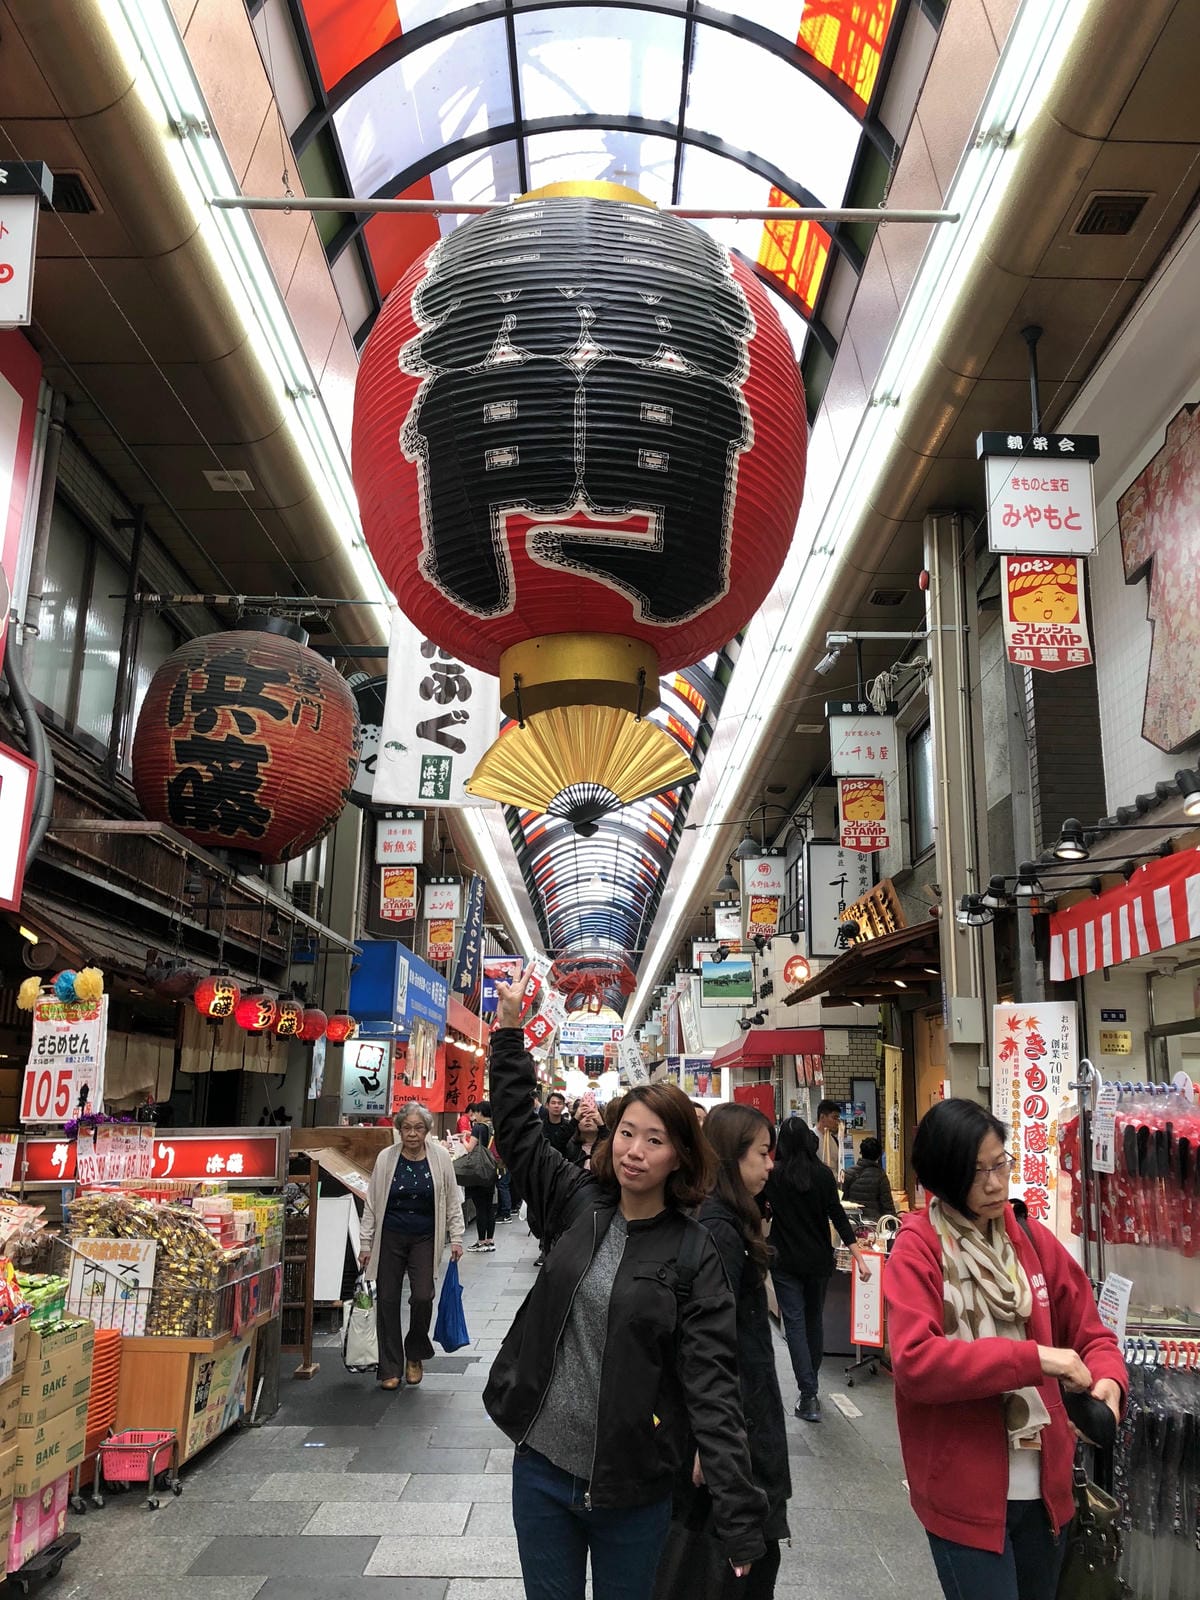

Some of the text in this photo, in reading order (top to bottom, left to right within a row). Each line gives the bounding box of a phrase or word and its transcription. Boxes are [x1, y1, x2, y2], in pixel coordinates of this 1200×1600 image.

[1011, 478, 1070, 492] きものと宝石
[1002, 503, 1083, 531] みやもと
[1009, 559, 1054, 577] クロモン
[1016, 622, 1073, 635] フレッシュ
[1011, 634, 1083, 647] STAMP
[1013, 648, 1085, 662] 加盟店
[842, 781, 870, 793] クロモン
[843, 828, 886, 836] STAMP
[844, 837, 887, 847] 加盟店
[749, 927, 776, 935] STAMP
[37, 1033, 90, 1055] ざらめせん
[1061, 1015, 1070, 1060] おかげ様で
[1049, 1039, 1063, 1096] 創業70周年
[22, 1070, 73, 1117] 105
[1023, 1031, 1051, 1219] きもの感謝祭
[79, 1156, 96, 1184] 229
[42, 1375, 67, 1397] BAKE
[36, 1441, 60, 1465] BAKE
